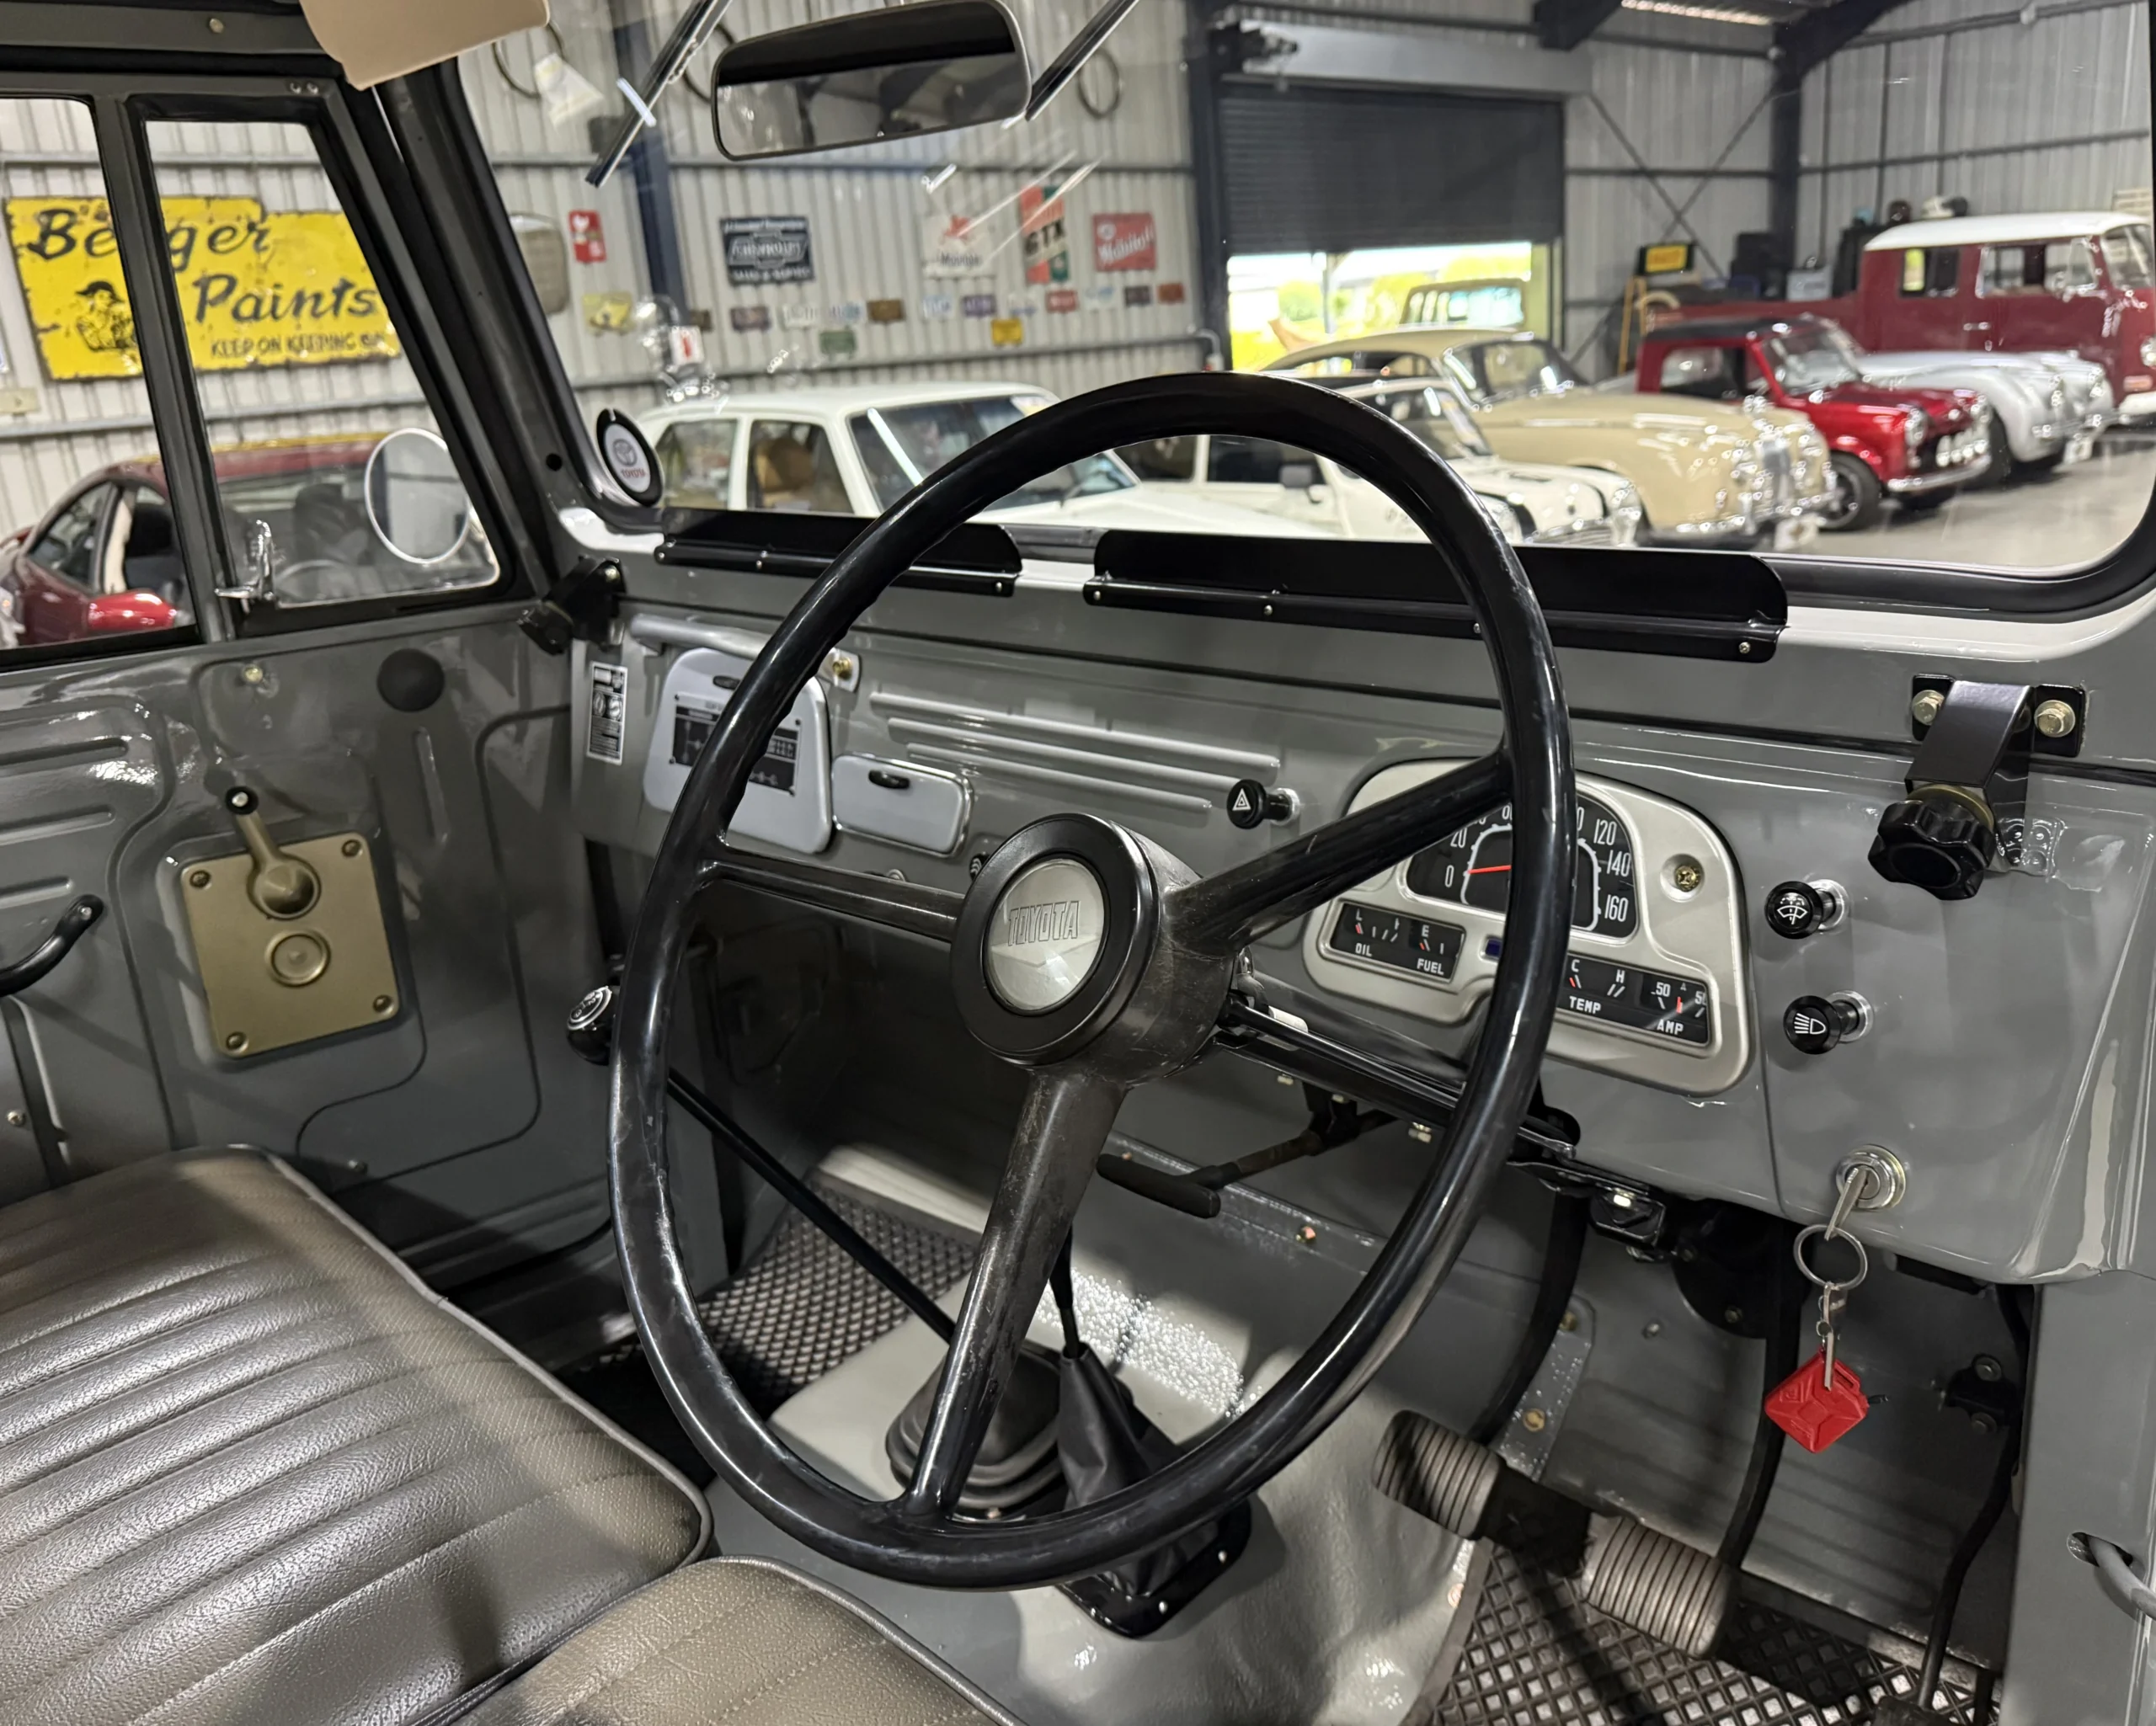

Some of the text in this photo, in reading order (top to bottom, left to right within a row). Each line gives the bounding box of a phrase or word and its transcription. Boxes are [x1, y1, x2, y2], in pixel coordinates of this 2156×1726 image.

[27, 208, 272, 273] Beger
[1024, 217, 1065, 257] GTX
[192, 273, 377, 323] Paints
[257, 334, 281, 354] ON
[1593, 818, 1618, 846] 120
[1606, 849, 1631, 877] 140
[1444, 864, 1455, 888] 0
[1355, 908, 1363, 922] L
[1604, 894, 1629, 922] 160
[1007, 900, 1080, 947] TOYOTA
[1421, 924, 1430, 938] E
[1355, 942, 1373, 957] OIL
[1417, 957, 1445, 976] FUEL
[1571, 959, 1581, 972] C
[1615, 969, 1625, 983] H
[1569, 995, 1602, 1015] TEMP
[1657, 1019, 1684, 1036] AMP
